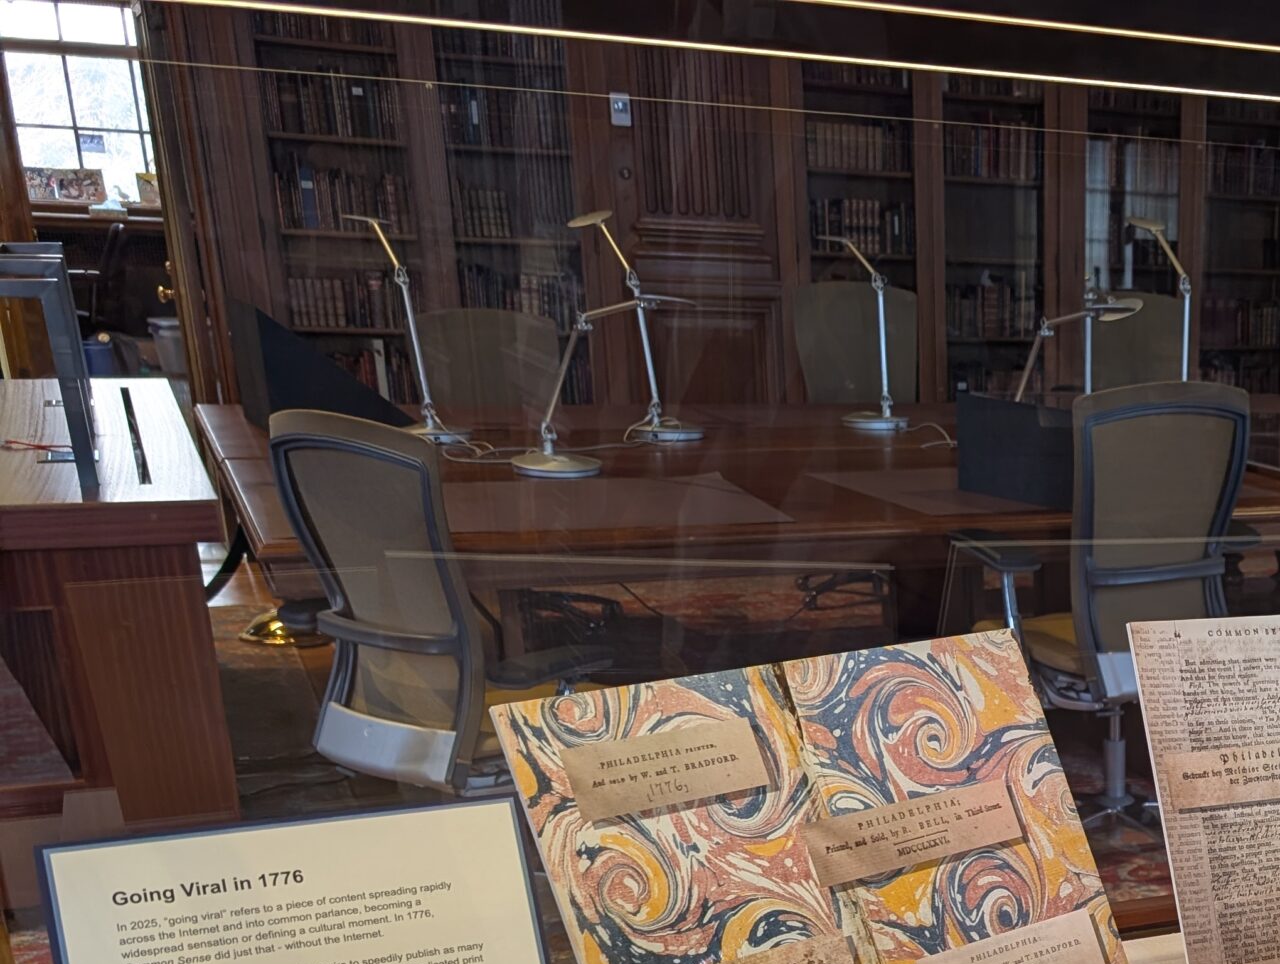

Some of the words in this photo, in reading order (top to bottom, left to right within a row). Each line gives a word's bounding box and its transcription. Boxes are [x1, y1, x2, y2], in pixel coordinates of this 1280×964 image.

[1207, 627, 1259, 638] COMMON
[599, 747, 681, 769] PHILADELPHIA
[627, 772, 638, 783] by
[639, 769, 652, 779] W.
[654, 766, 667, 776] and
[683, 752, 740, 770] BRADFORD.
[853, 837, 867, 847] and
[889, 828, 900, 839] by
[901, 824, 911, 834] R.
[953, 812, 962, 820] in
[964, 805, 984, 817] Third
[111, 887, 176, 907] Going
[179, 877, 228, 898] Viral
[232, 876, 253, 892] in
[257, 869, 304, 888] 1776
[116, 922, 128, 933] In
[229, 906, 261, 918] refers
[262, 904, 274, 913] to
[285, 900, 314, 912] piece
[315, 896, 327, 906] of
[328, 891, 367, 905] content
[368, 886, 418, 901] spreading
[419, 881, 452, 894] rapidly
[119, 934, 156, 946] across
[157, 930, 176, 941] the
[178, 923, 221, 938] Internet
[222, 920, 243, 933] and
[244, 918, 266, 929] into
[266, 913, 313, 927] common
[363, 899, 413, 913] becoming
[120, 941, 185, 960] widespread
[186, 936, 239, 951] sensation
[240, 934, 253, 944] or
[254, 928, 297, 942] defining
[308, 920, 346, 934] cultural
[393, 913, 405, 922] In
[214, 949, 231, 961] did
[232, 946, 254, 960] just
[254, 943, 276, 956] that
[284, 937, 323, 951] without
[323, 935, 341, 945] the
[1033, 937, 1081, 959] BRADFORD.
